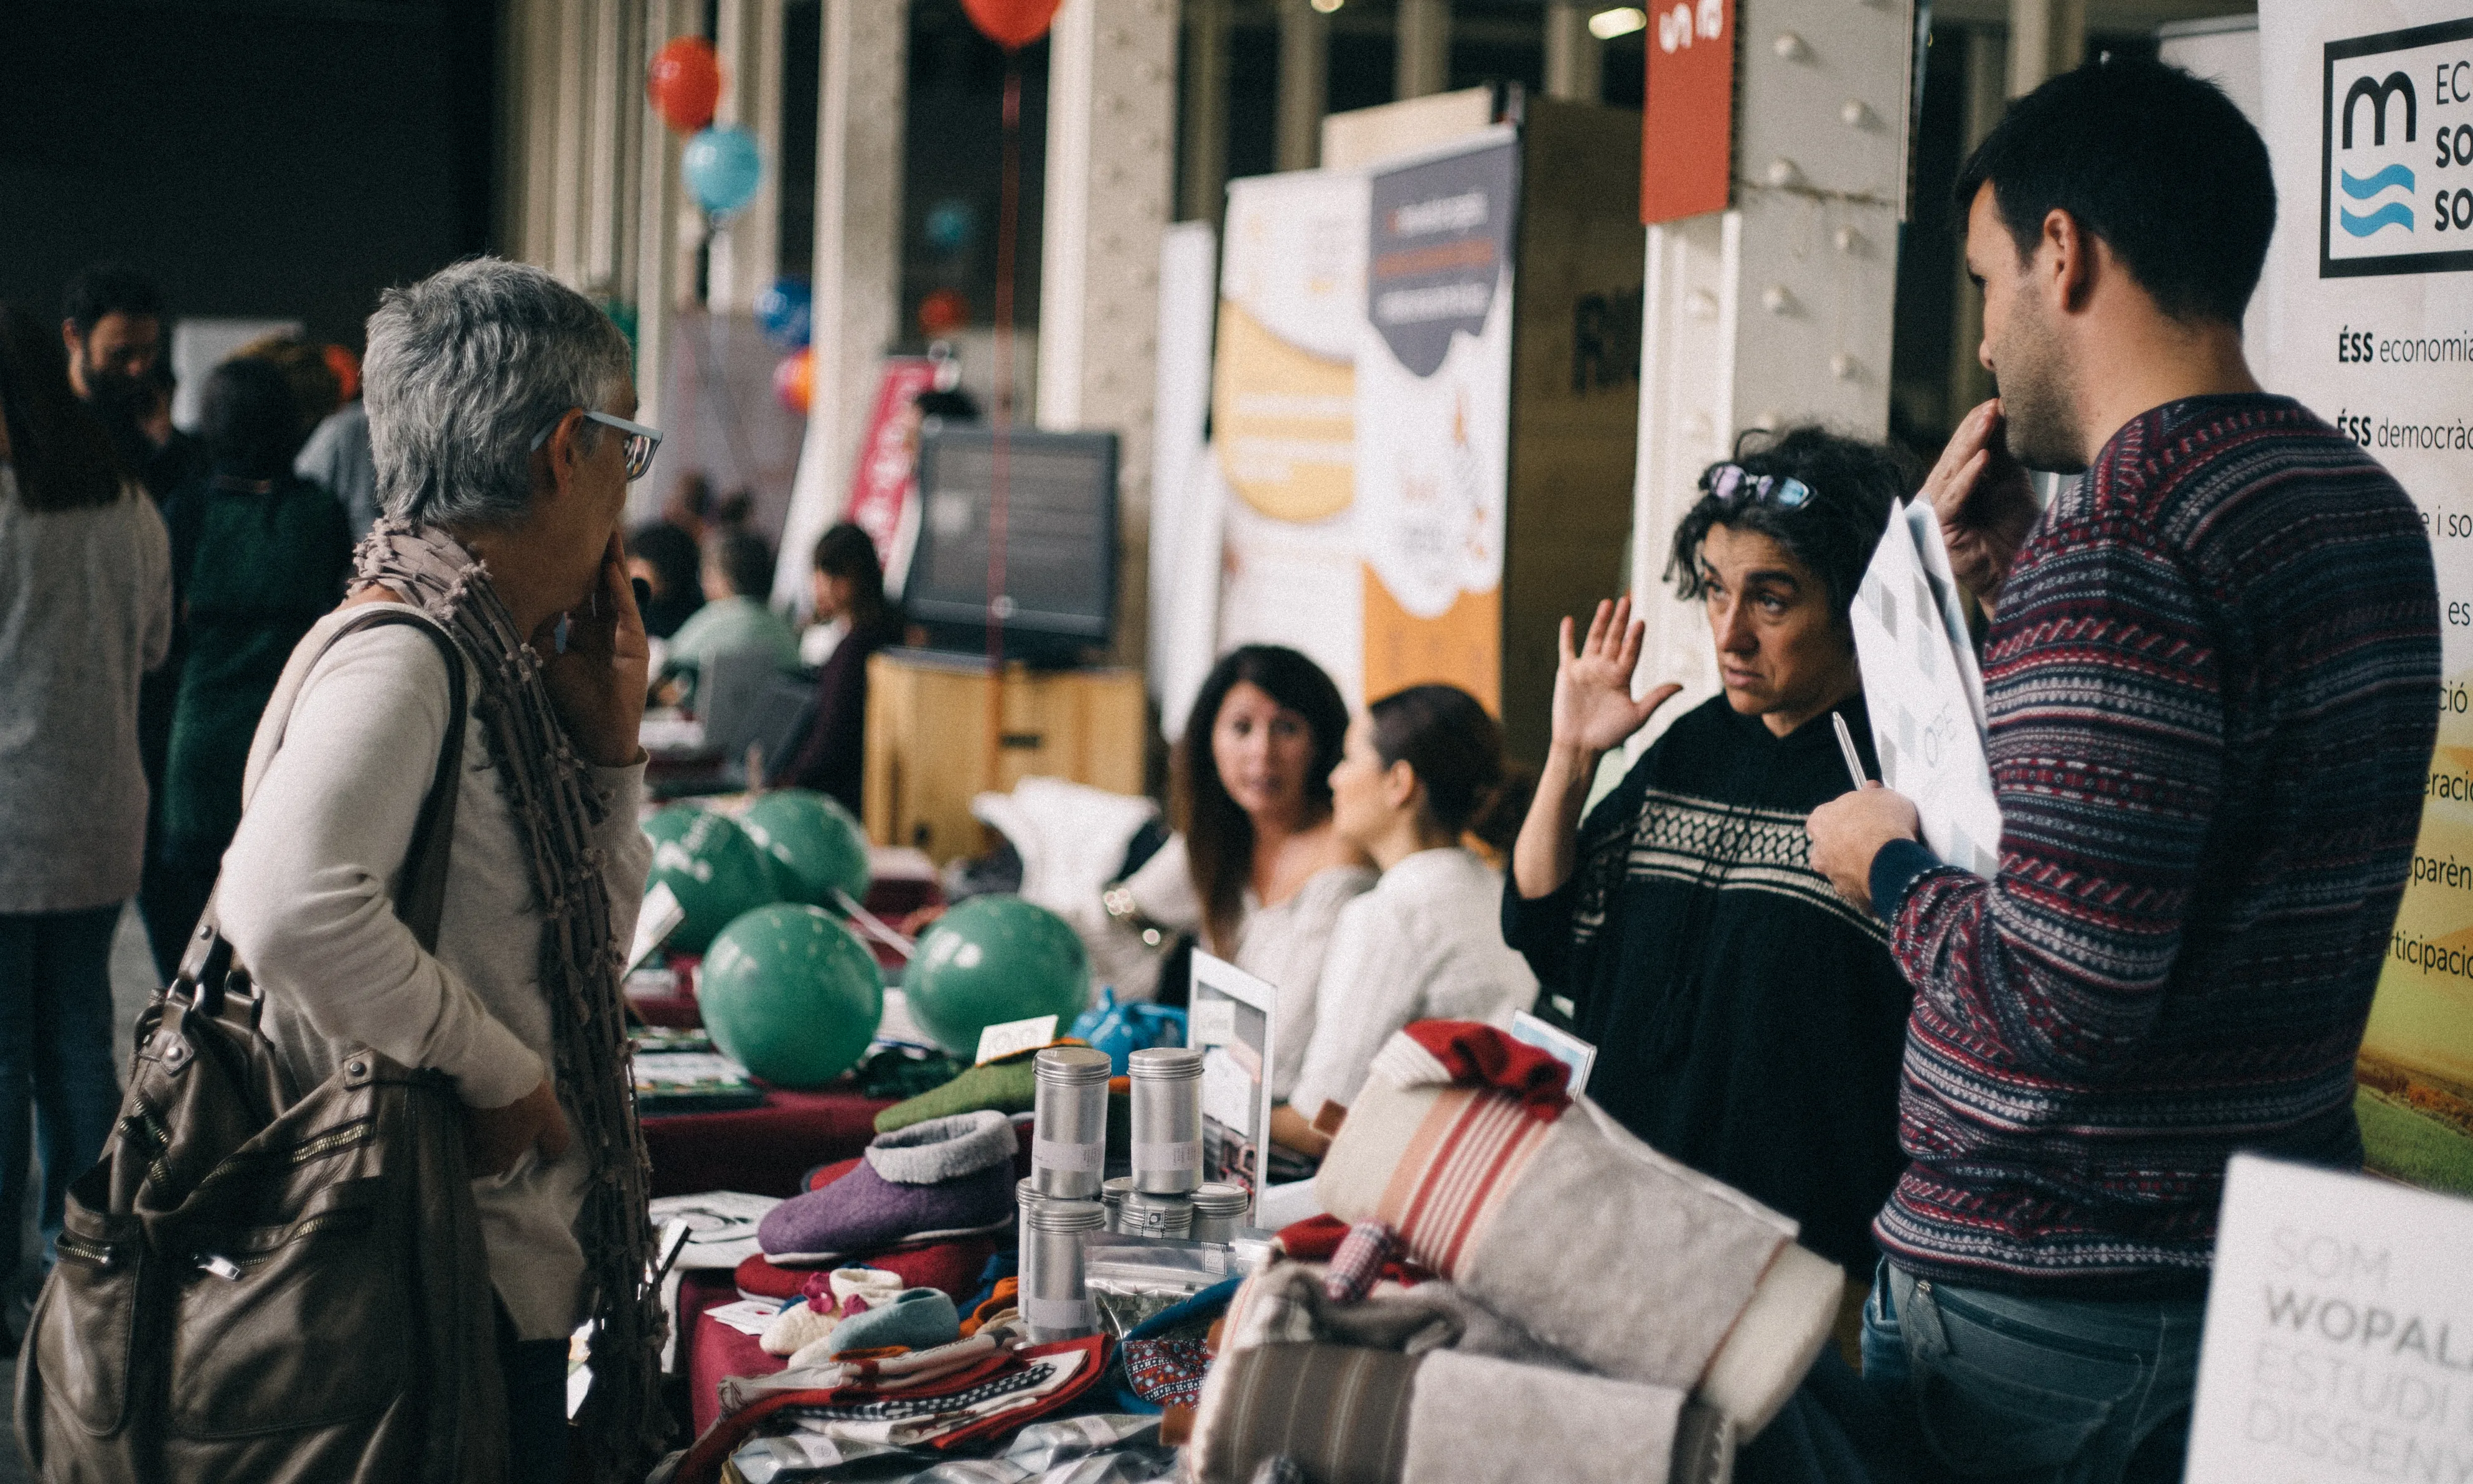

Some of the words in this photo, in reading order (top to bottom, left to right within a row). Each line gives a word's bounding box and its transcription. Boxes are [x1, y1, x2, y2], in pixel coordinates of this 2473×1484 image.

[2436, 124, 2473, 168] SO
[2434, 188, 2473, 232] SO
[2339, 324, 2373, 362] ÉSS
[2448, 514, 2472, 538] so
[2448, 601, 2471, 626] es
[2269, 1222, 2392, 1292] SOM
[2263, 1280, 2473, 1373] WOPAL
[2253, 1337, 2452, 1427] ESTUDI
